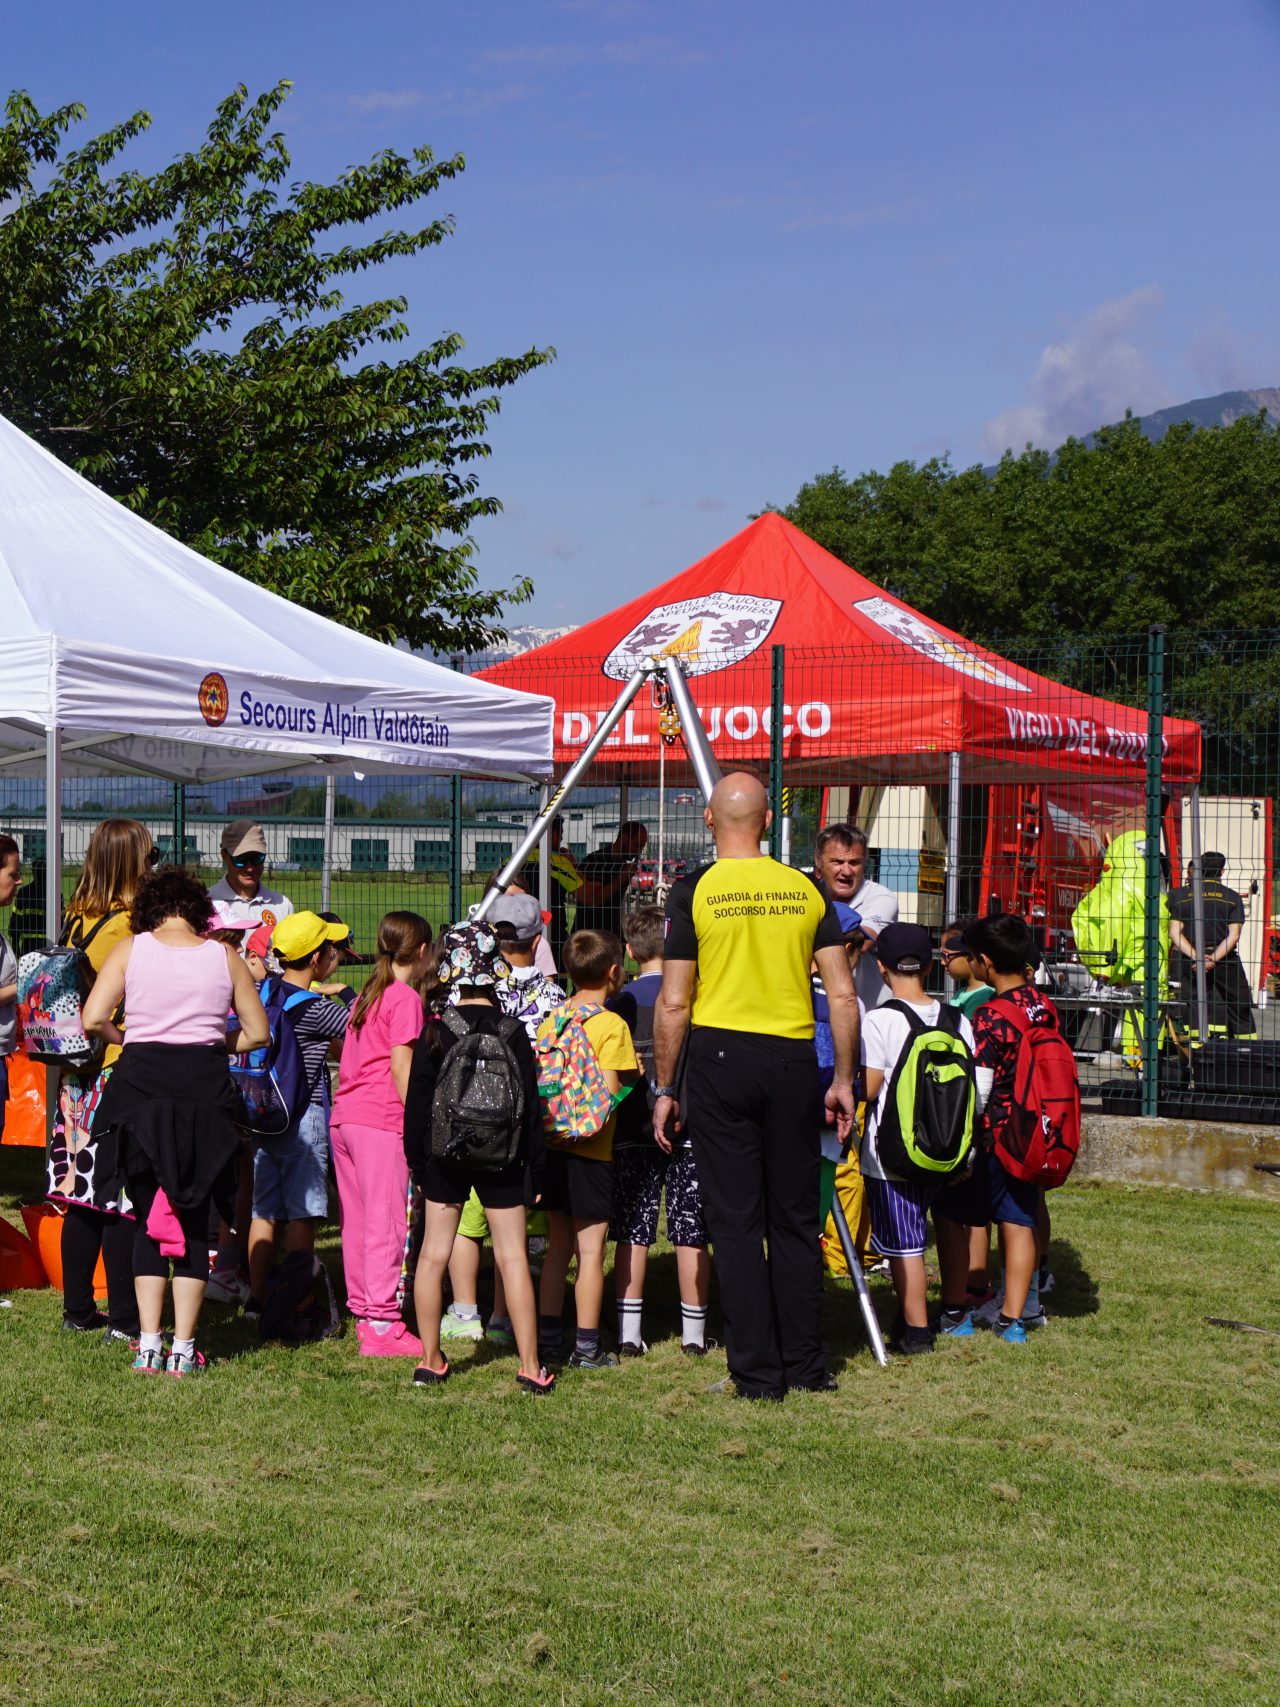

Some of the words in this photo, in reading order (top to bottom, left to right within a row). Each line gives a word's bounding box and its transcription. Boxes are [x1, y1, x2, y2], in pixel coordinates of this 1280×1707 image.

[728, 596, 774, 608] FUOCO
[649, 604, 706, 620] SAPEURS
[239, 690, 317, 734] Secours
[321, 702, 368, 745] Alpin
[372, 707, 450, 748] Valdôtain
[695, 701, 832, 742] UOCO
[1005, 706, 1064, 750] VIGILI
[1065, 717, 1101, 756] DEL
[706, 891, 752, 906] GUARDIA
[753, 891, 764, 902] di
[766, 891, 809, 901] FINANZA
[713, 905, 766, 919] SOCCORSO
[769, 905, 806, 916] ALPINO
